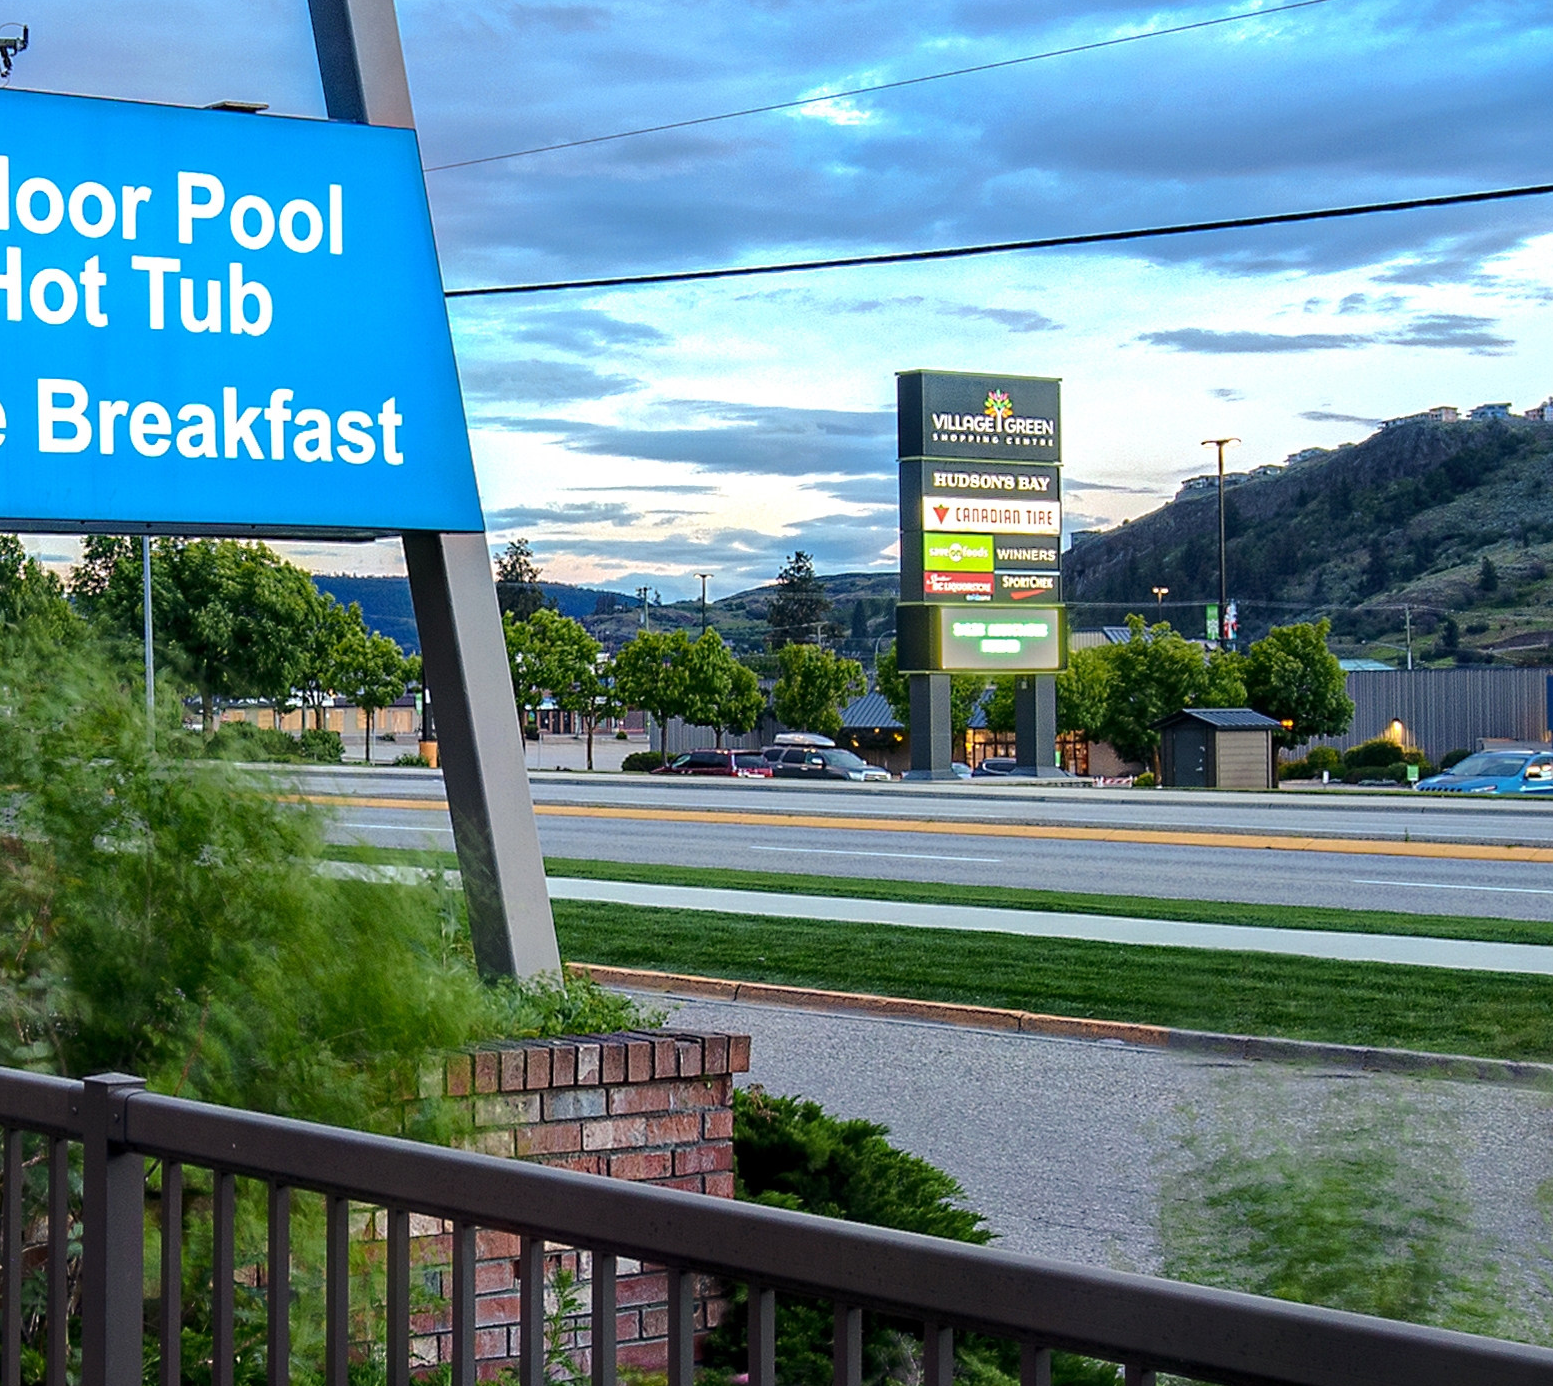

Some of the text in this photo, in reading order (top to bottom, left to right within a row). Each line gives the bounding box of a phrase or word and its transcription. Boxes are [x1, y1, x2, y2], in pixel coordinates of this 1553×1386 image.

[176, 170, 344, 255] Pool
[131, 254, 274, 336] Tub
[36, 377, 405, 466] Breakfast
[932, 413, 1054, 436] VILLAGE GREEN
[932, 434, 1055, 447] SHOPPING CENTRE
[932, 472, 1051, 492] HUDSON'S BAY
[955, 508, 1053, 526] CANADIAN TIRE
[996, 548, 1056, 561] WINNERS
